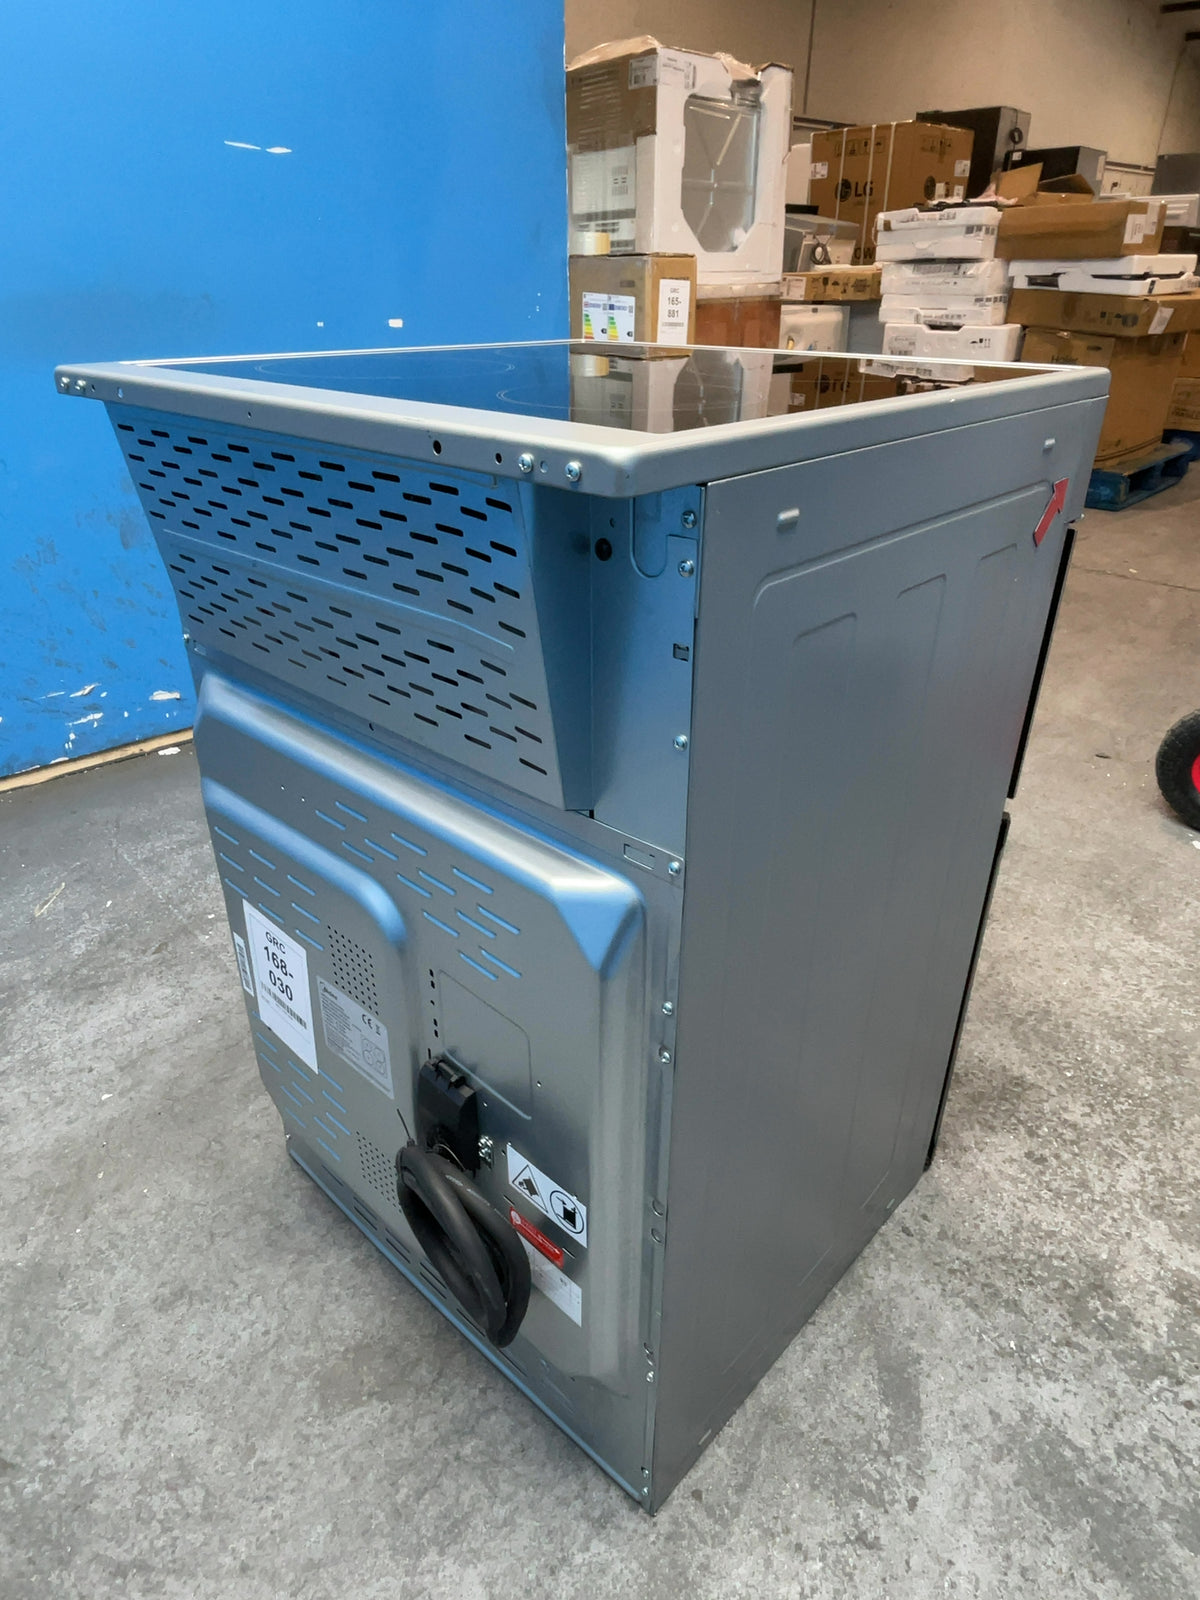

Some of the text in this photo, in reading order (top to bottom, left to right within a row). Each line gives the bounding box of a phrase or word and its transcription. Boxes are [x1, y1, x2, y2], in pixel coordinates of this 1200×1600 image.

[854, 181, 874, 197] LG
[667, 296, 682, 305] 165-
[667, 309, 679, 318] 881
[265, 931, 287, 955] GRC
[263, 946, 294, 979] 168-
[268, 970, 293, 1002] 030
